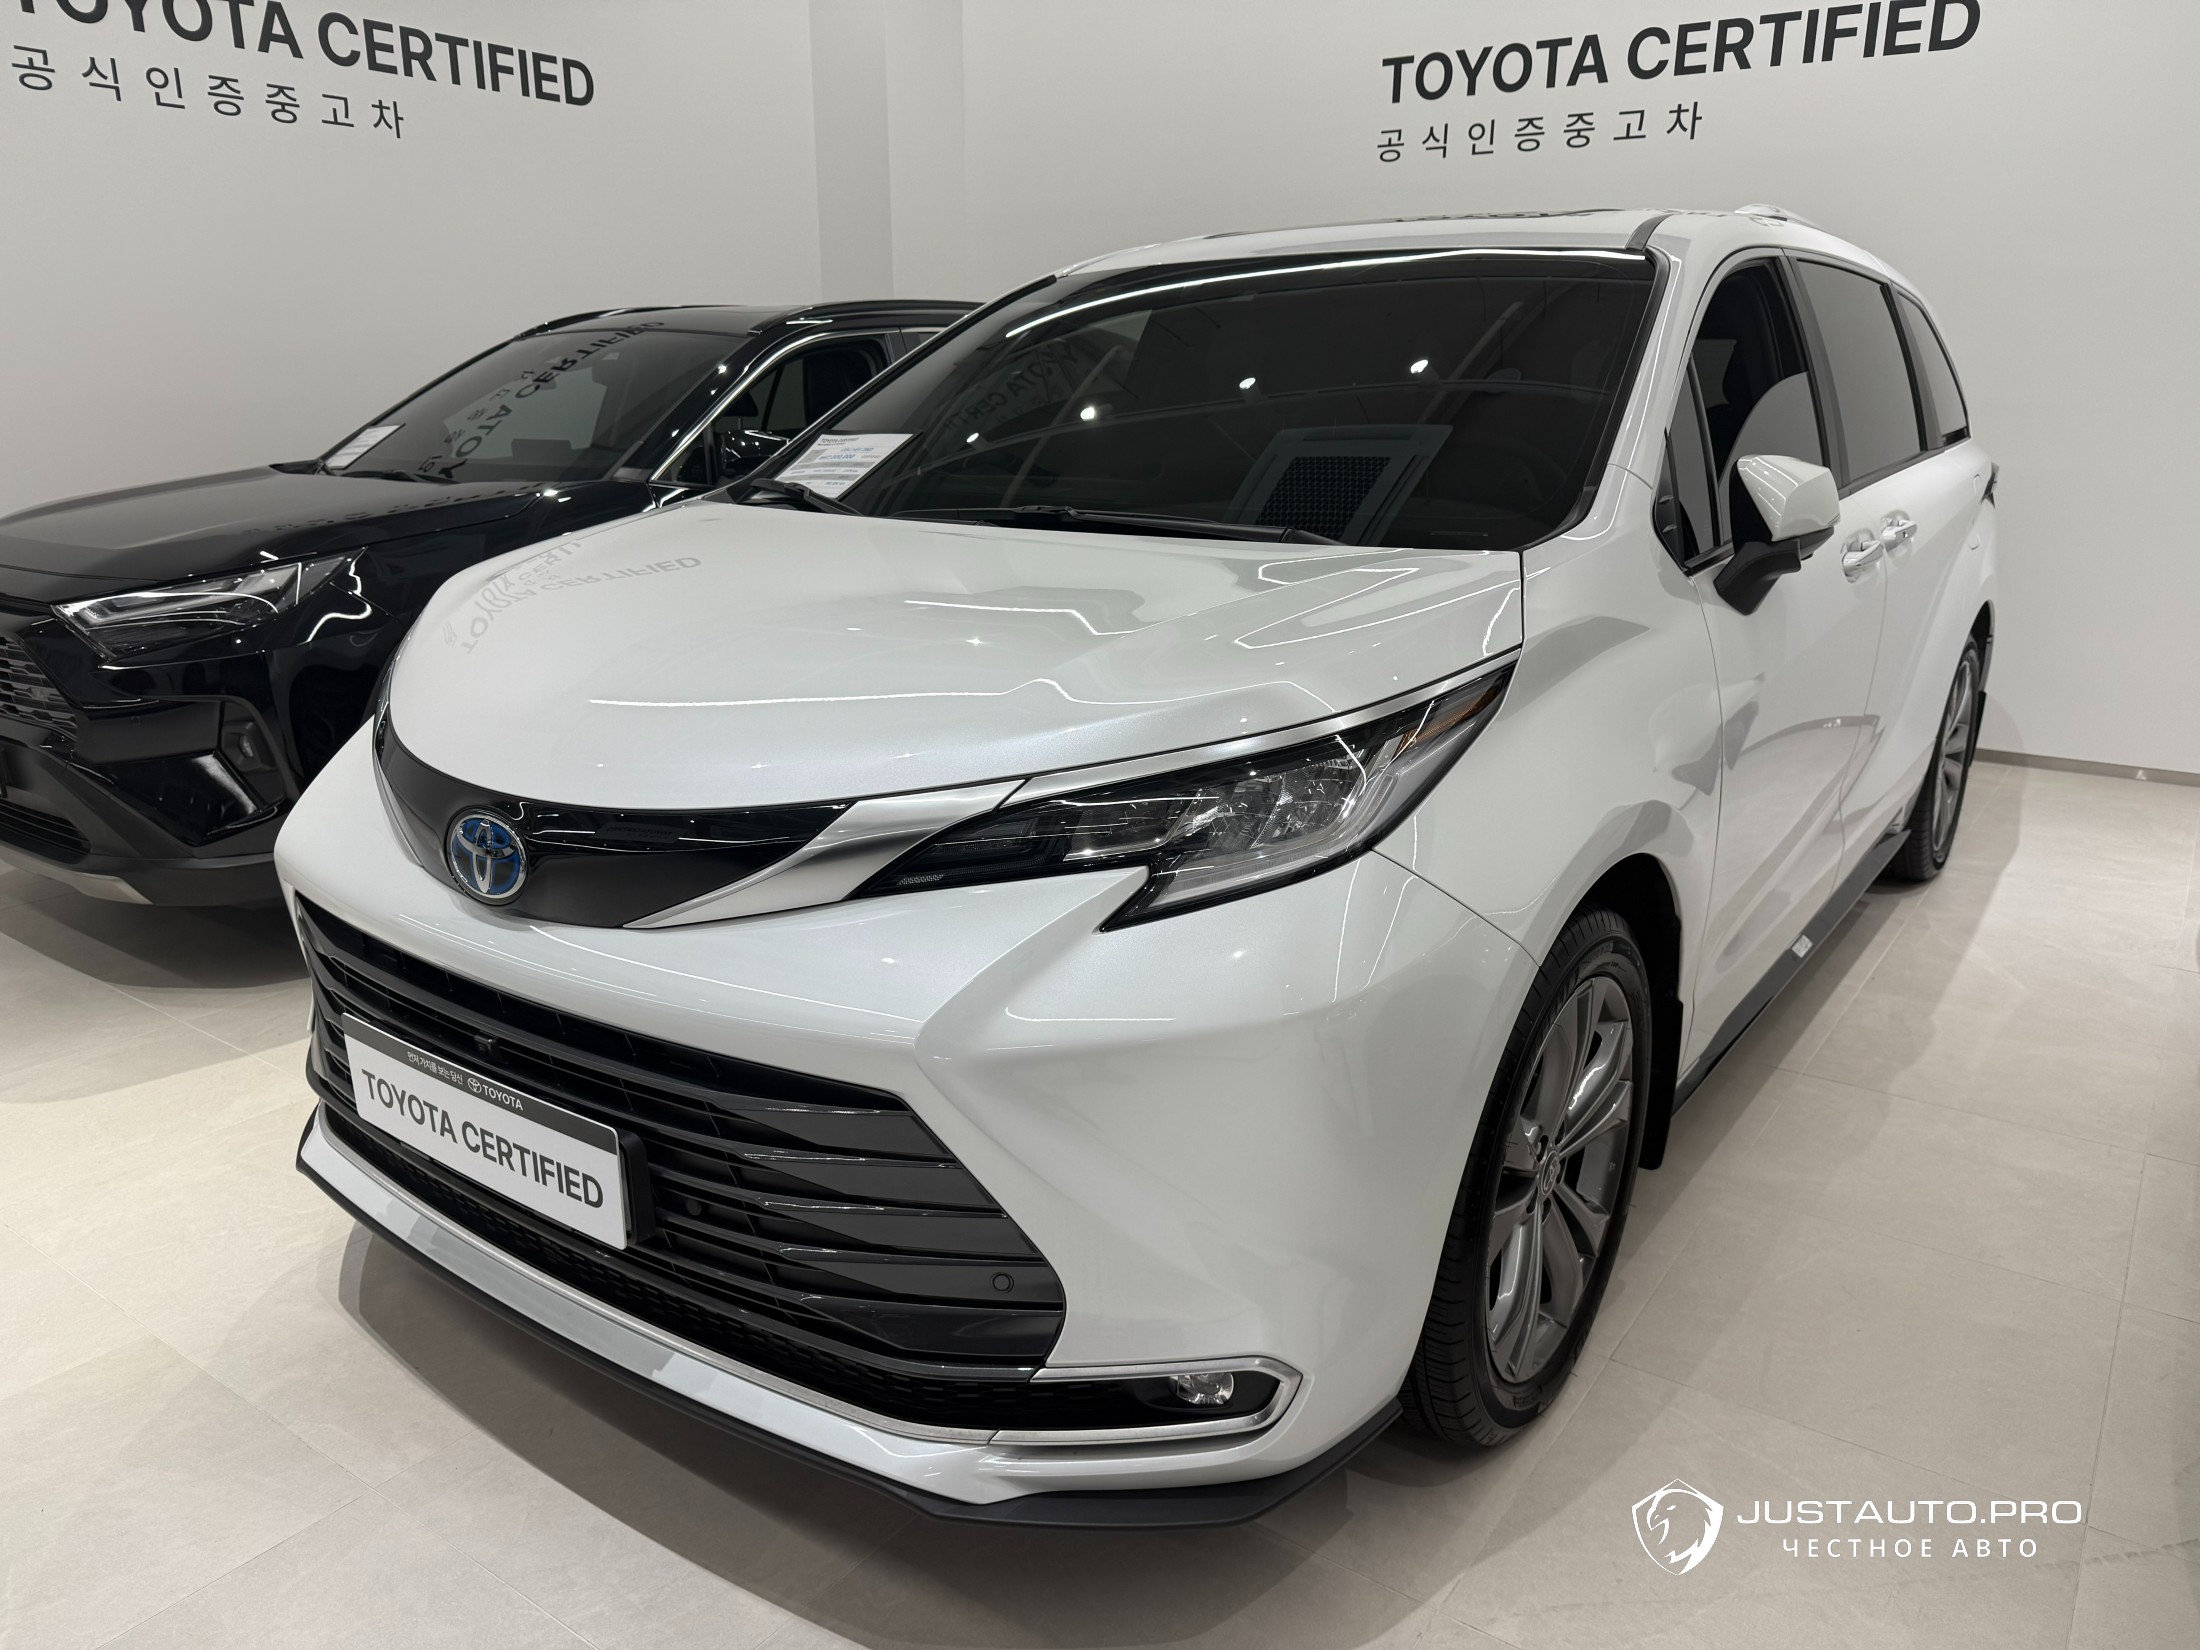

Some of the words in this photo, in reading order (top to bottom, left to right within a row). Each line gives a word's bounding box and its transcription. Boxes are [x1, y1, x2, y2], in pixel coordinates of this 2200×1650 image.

[317, 12, 595, 107] CERTIFIED
[1381, 34, 1609, 104] TOYOTA
[1627, 0, 1981, 80] CERTIFIED
[361, 1069, 458, 1144] TOYOTA
[461, 1120, 604, 1209] CERTIFIED
[482, 1084, 524, 1111] TOYOTA
